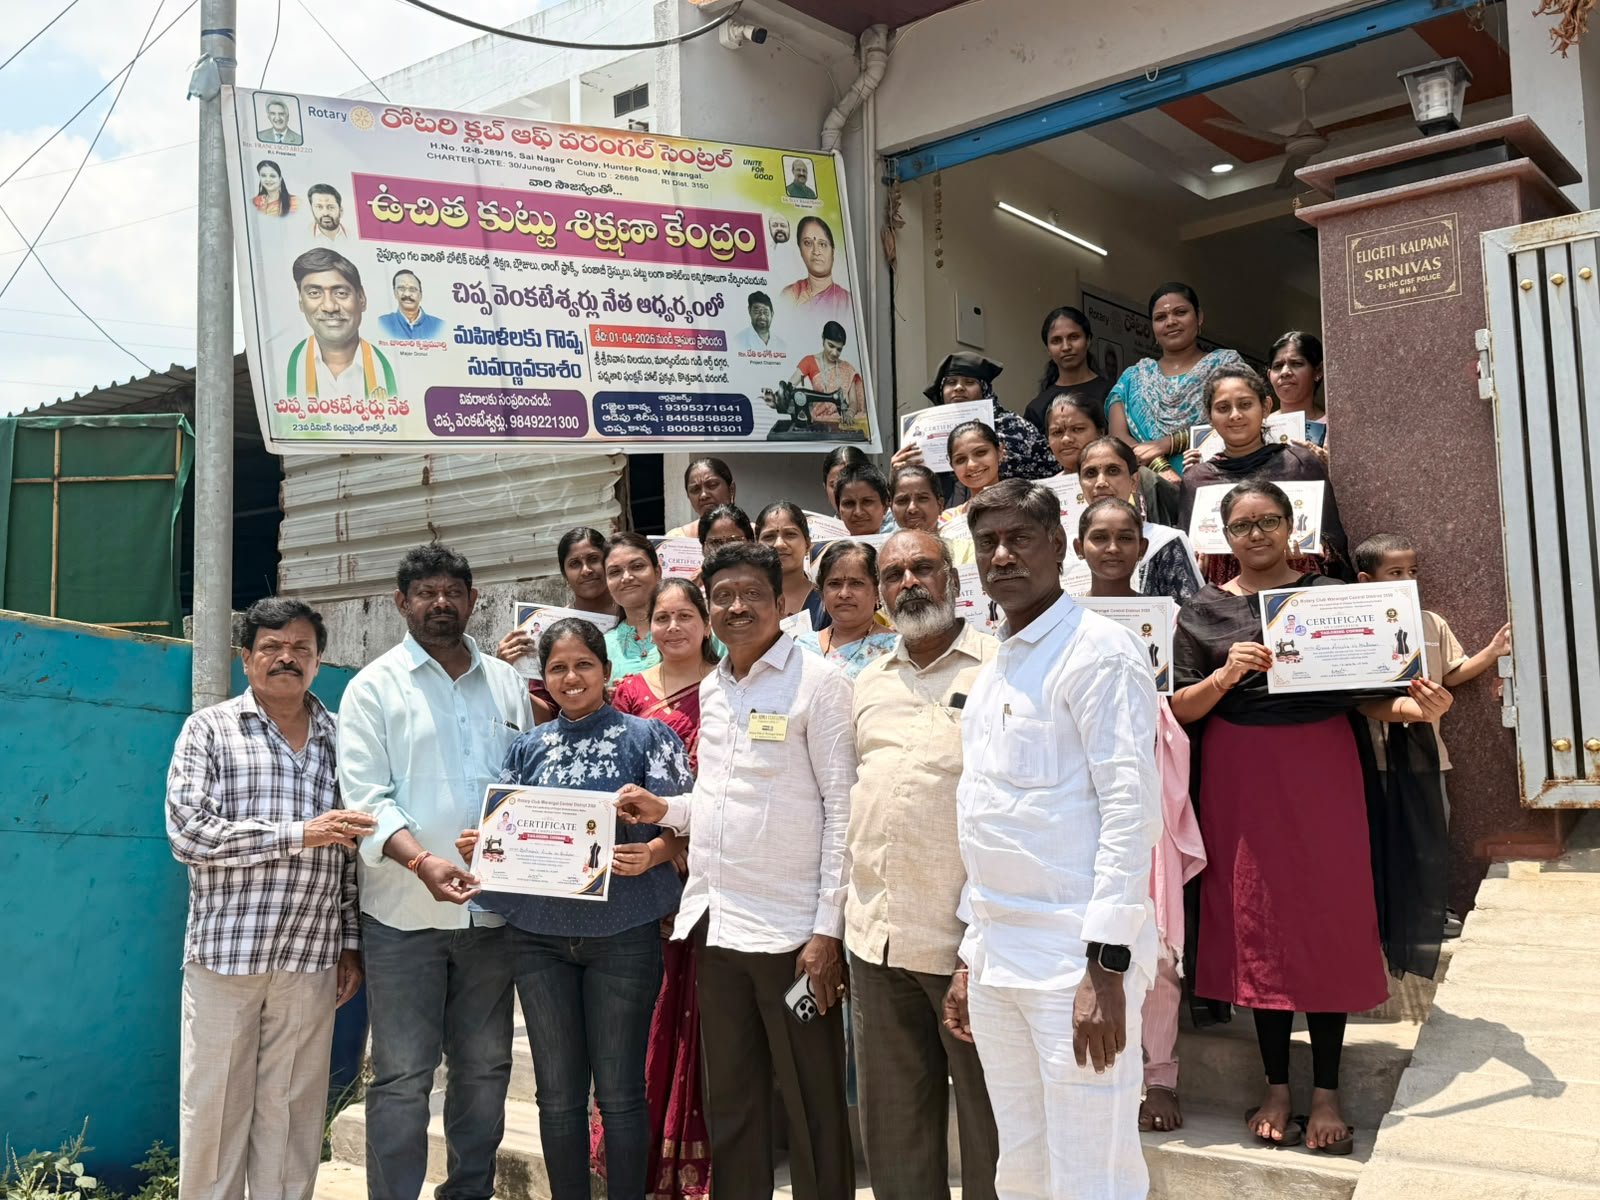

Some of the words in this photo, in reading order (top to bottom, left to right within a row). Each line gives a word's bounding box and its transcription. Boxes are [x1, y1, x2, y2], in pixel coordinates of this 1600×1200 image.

[308, 106, 347, 122] Rotary
[381, 107, 458, 136] రోటరి
[463, 120, 505, 145] క్లబ్
[511, 127, 553, 150] ఆఫ్
[558, 132, 655, 160] వరంగల్
[658, 144, 733, 173] సెంట్రల్
[426, 152, 475, 164] CHARTER
[478, 157, 505, 167] DATE:
[430, 142, 458, 152] H.No.
[519, 152, 534, 161] Sai
[537, 154, 564, 165] Nagar
[566, 158, 601, 169] Colony,
[603, 162, 633, 172] Hunter
[635, 166, 660, 175] Road,
[577, 169, 597, 178] Club
[598, 171, 607, 179] ID
[751, 166, 765, 174] FOR
[754, 172, 774, 181] GOOD
[528, 178, 552, 189] వారి
[691, 181, 709, 190] 3150
[367, 183, 469, 229] ఉచిత
[476, 199, 557, 248] కుట్టు
[564, 209, 658, 258] శిక్షణా
[661, 209, 756, 262] కేంద్రం
[1356, 244, 1396, 264] ELIGETI
[1400, 233, 1450, 255] KALPANA
[1364, 256, 1442, 283] SRINIVAS
[1400, 277, 1415, 286] CISF
[1416, 272, 1441, 283] POLICE
[452, 280, 493, 316] చిప్ప
[491, 284, 600, 319] వెంకటేశ్వర్లు
[600, 288, 633, 313] నేత
[636, 292, 725, 324] ఆధ్వర్యంలో
[453, 325, 542, 348] మహిళలకు
[545, 329, 584, 355] గొప్ప
[274, 398, 306, 419] చిప్ప
[307, 395, 385, 421] వెంకటేశ్వర్లు
[388, 397, 410, 416] నేత
[510, 415, 579, 429] 9849221300
[1305, 614, 1375, 626] CERTIFICATE
[516, 819, 577, 831] CERTIFICATE
